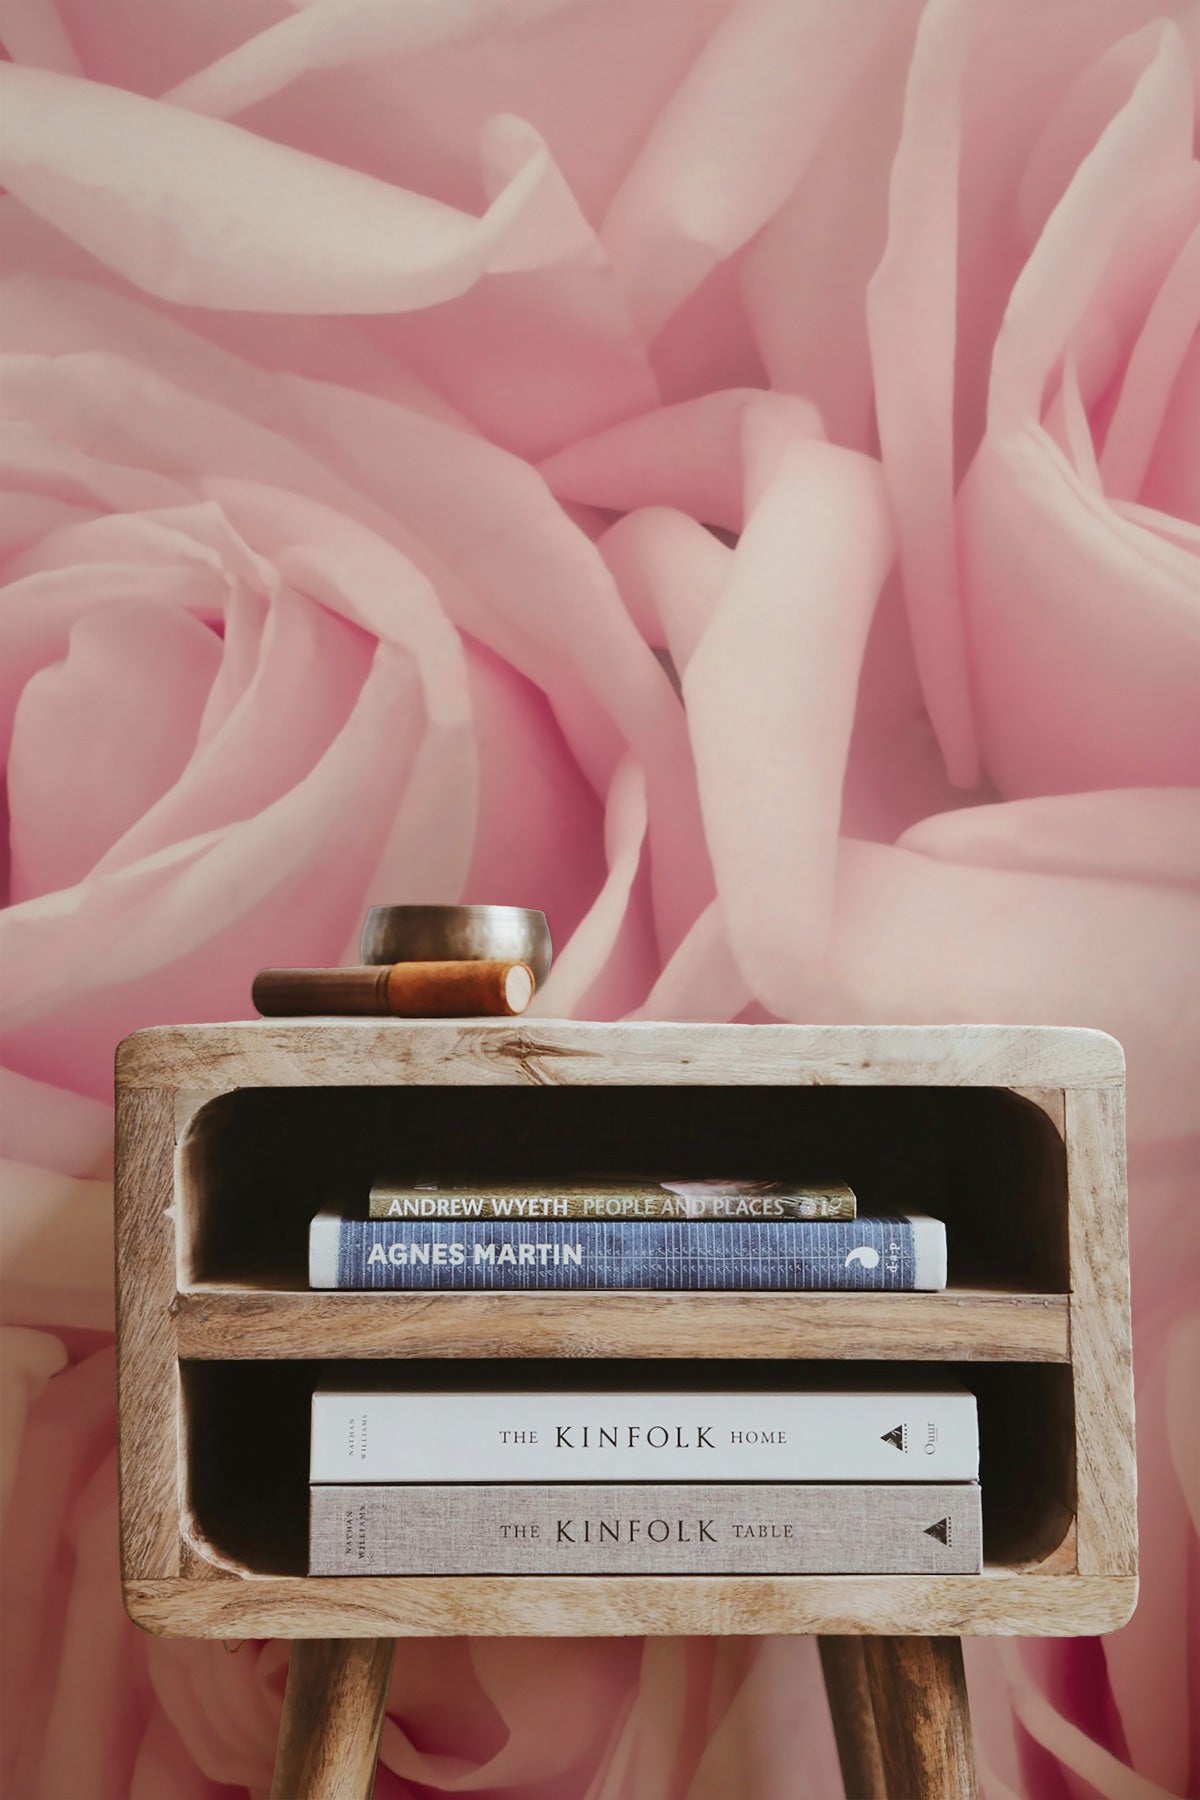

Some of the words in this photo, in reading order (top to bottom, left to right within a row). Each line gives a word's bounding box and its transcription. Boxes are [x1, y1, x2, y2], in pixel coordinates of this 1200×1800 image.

[387, 1199, 484, 1216] ANDREW
[491, 1199, 568, 1216] WYETH
[584, 1199, 658, 1216] PEOPLE
[661, 1199, 705, 1216] AND
[712, 1199, 784, 1216] PLACES
[367, 1243, 465, 1265] AGNES
[474, 1243, 583, 1265] MARTIN
[499, 1431, 538, 1443] THE
[555, 1426, 716, 1448] KINFOLK
[731, 1431, 787, 1443] HOME
[500, 1525, 540, 1537] THE
[556, 1519, 718, 1542] KINFOLK
[733, 1525, 794, 1537] TABLE
